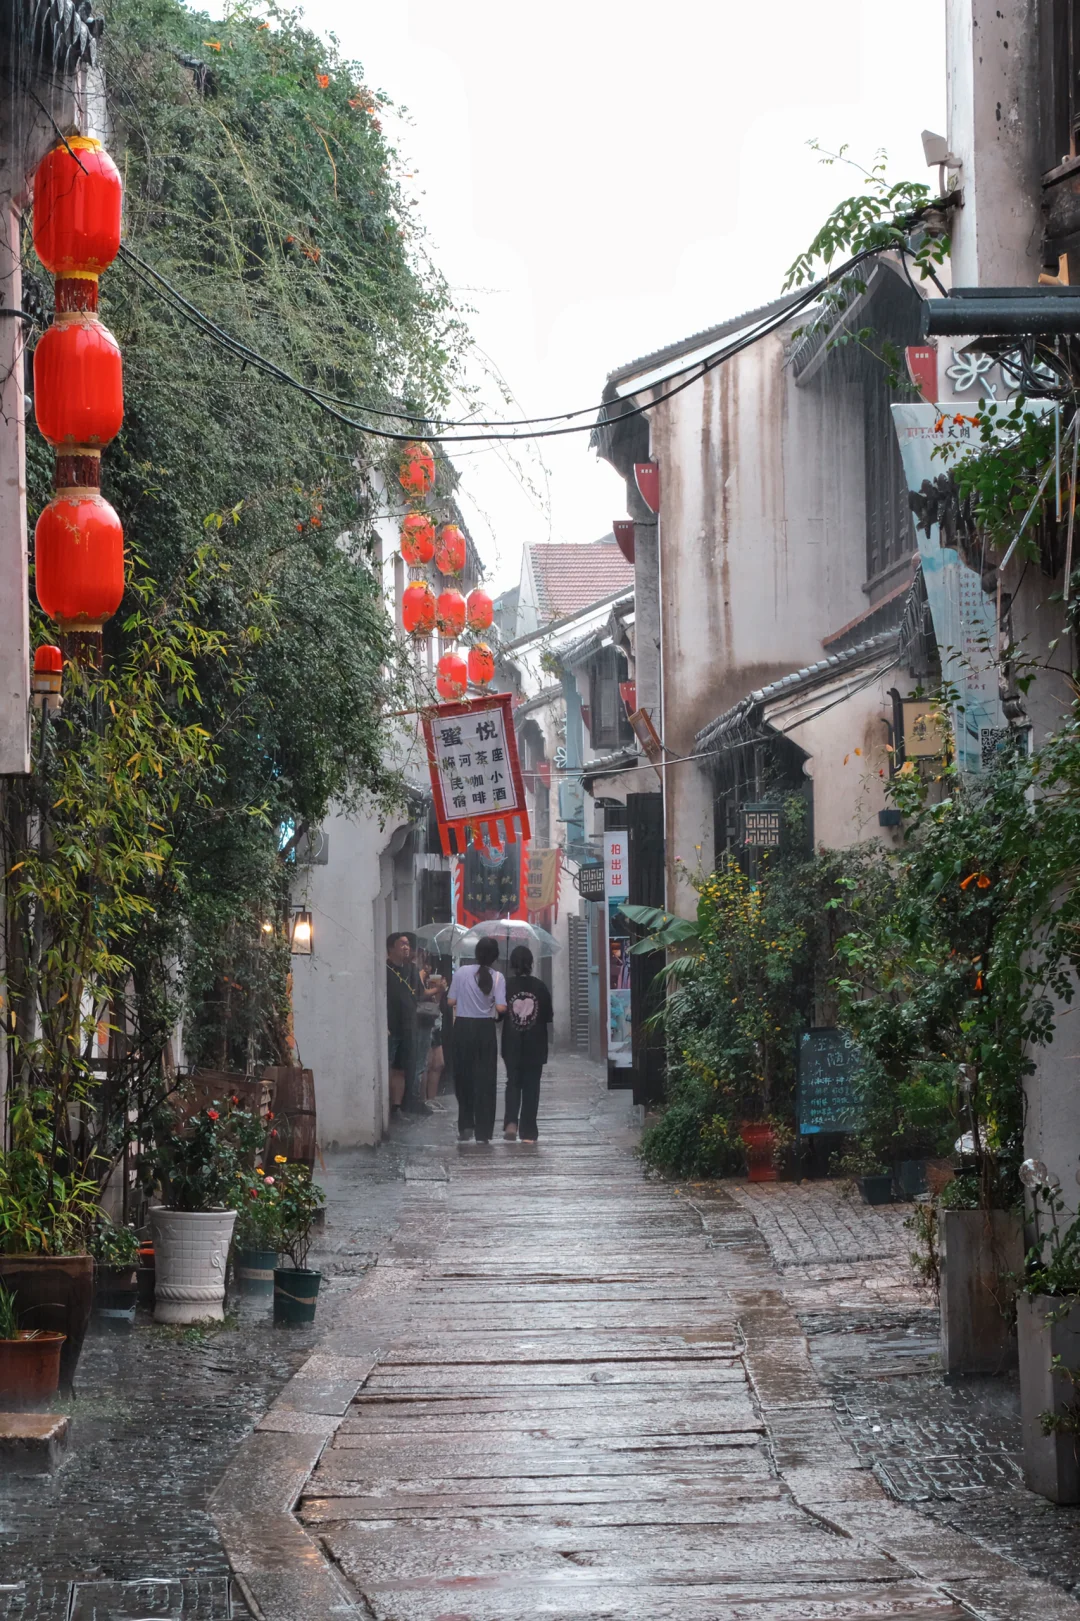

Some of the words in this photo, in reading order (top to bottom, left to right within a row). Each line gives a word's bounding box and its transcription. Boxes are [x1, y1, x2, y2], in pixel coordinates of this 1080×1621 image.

[948, 425, 970, 439] 天朗
[440, 720, 499, 748] 蜜悦
[442, 748, 504, 771] 临河茶座
[451, 776, 467, 809] 民宿
[470, 774, 487, 804] 咖啡
[490, 771, 507, 801] 小酒
